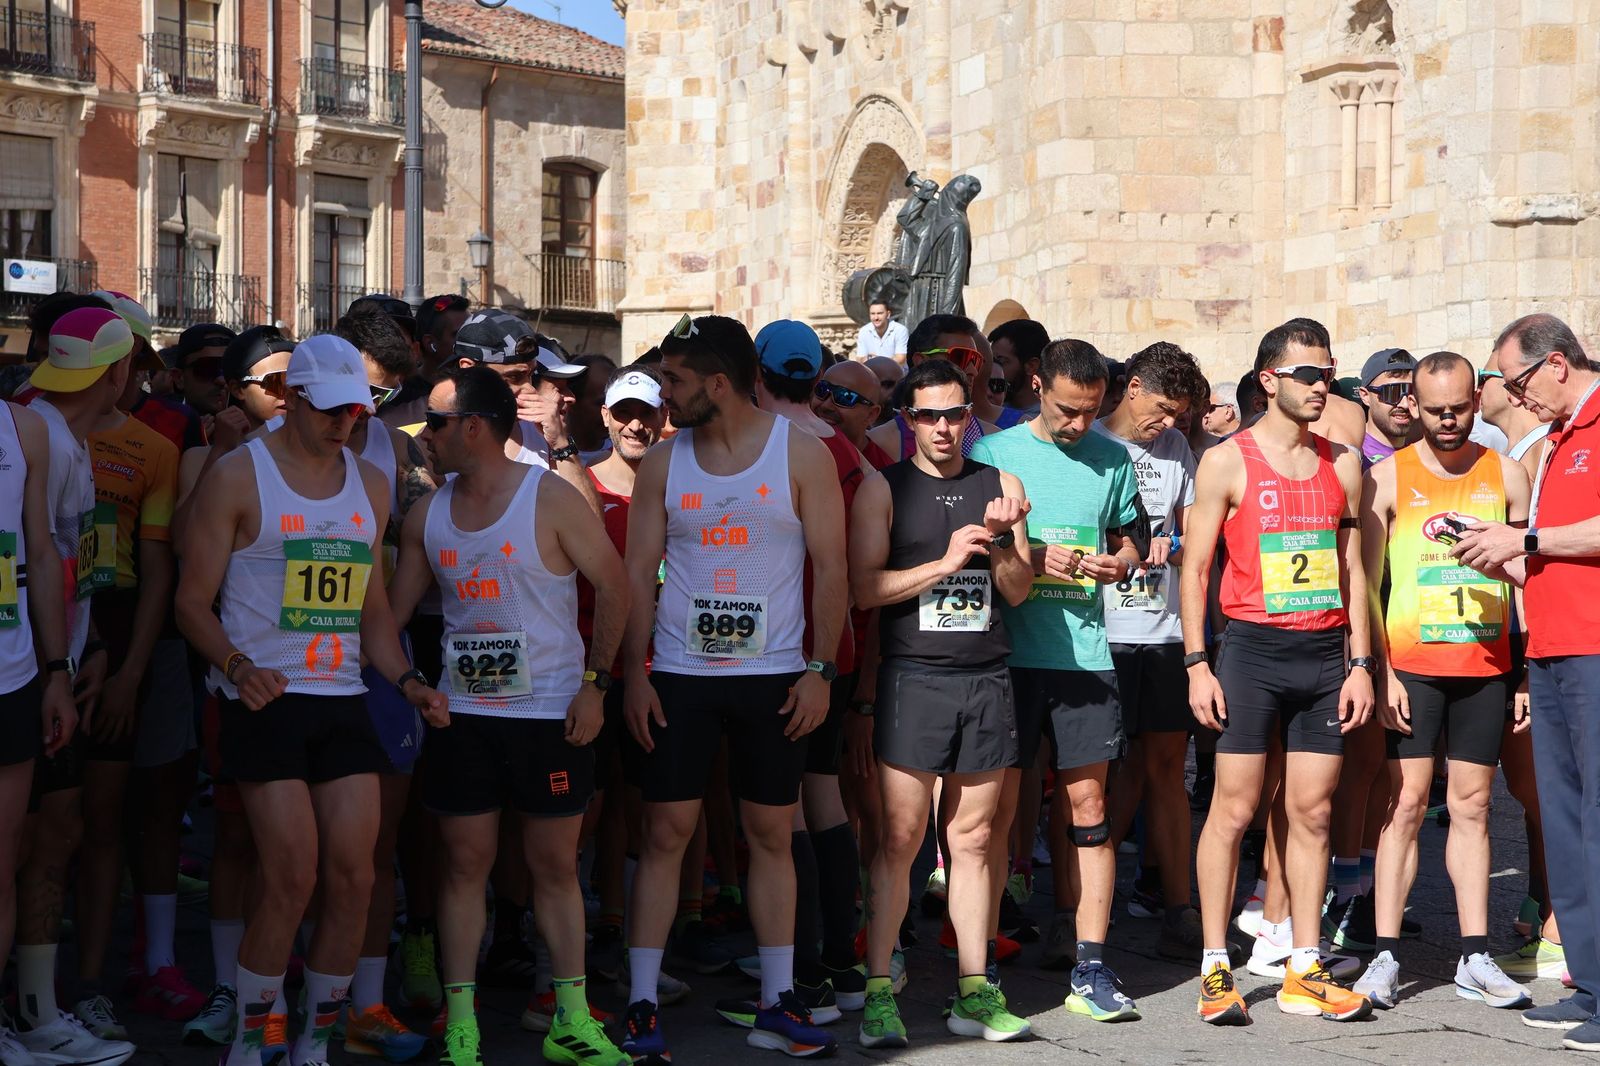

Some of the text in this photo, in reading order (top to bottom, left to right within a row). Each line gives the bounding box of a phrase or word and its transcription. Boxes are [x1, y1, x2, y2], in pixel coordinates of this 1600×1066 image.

[1133, 462, 1154, 471] DIA
[1287, 515, 1324, 524] vistasol
[330, 549, 352, 557] RURAL
[1291, 553, 1310, 585] 2
[298, 564, 352, 604] 161
[947, 576, 988, 586] ZAMORA
[931, 588, 985, 611] 733
[1041, 589, 1091, 600] CAJA RURAL
[694, 598, 763, 613] 10K ZAMORA
[1289, 596, 1337, 606] CAJA RURAL
[1450, 586, 1464, 617] 1
[310, 616, 357, 626] CAJA RURAL
[697, 612, 756, 638] 889
[1445, 628, 1497, 638] CAJA RURAL
[453, 639, 522, 651] 10K ZAMORA
[457, 652, 518, 678] 822
